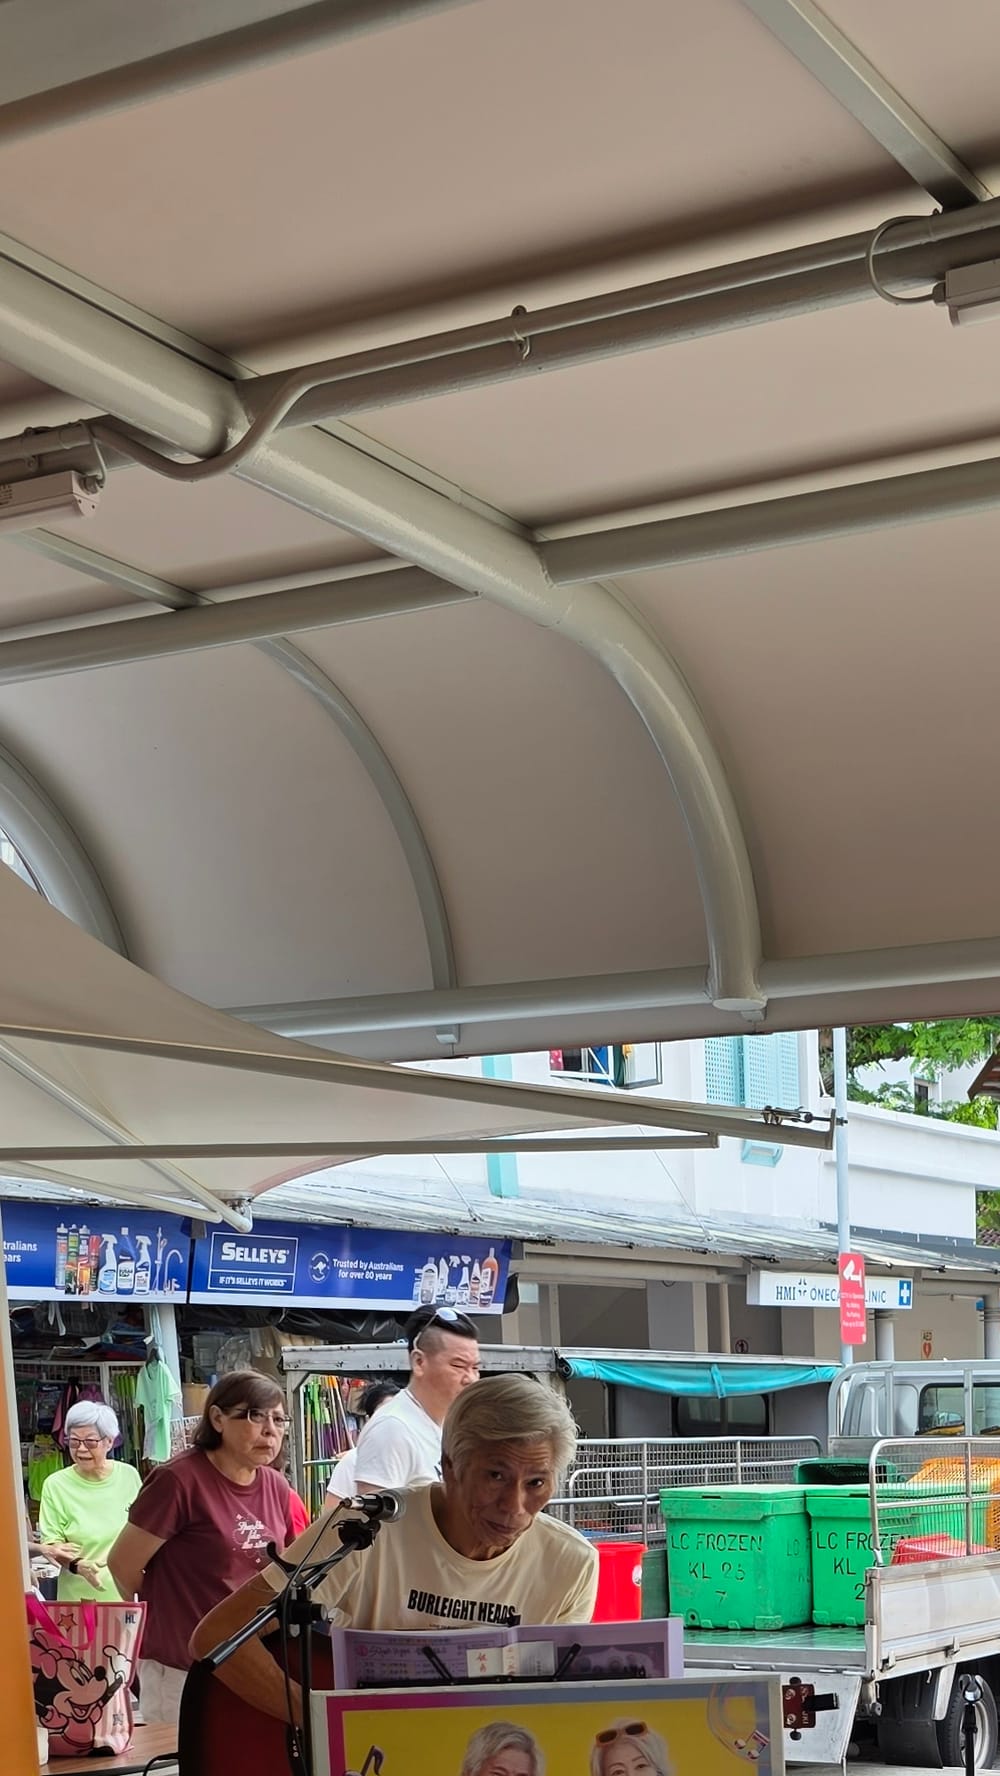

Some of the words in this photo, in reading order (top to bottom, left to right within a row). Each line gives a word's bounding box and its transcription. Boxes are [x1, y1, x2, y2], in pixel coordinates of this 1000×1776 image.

[2, 1240, 38, 1252] tralians
[221, 1242, 287, 1264] SELLEYS
[3, 1254, 22, 1263] ears
[333, 1258, 359, 1269] Trusted
[359, 1260, 369, 1271] by
[368, 1261, 404, 1272] Australians
[338, 1269, 349, 1278] for
[349, 1271, 364, 1280] over
[364, 1271, 374, 1280] 80
[374, 1273, 393, 1281] years
[775, 1286, 796, 1301] HMI
[671, 1532, 690, 1550] LC
[696, 1533, 763, 1551] FROZEN
[816, 1532, 839, 1550] LC
[688, 1561, 712, 1579] KL
[834, 1557, 856, 1575] KL
[854, 1582, 866, 1600] 2
[407, 1589, 477, 1621] BURLEIGHT
[477, 1601, 516, 1626] HEADS
